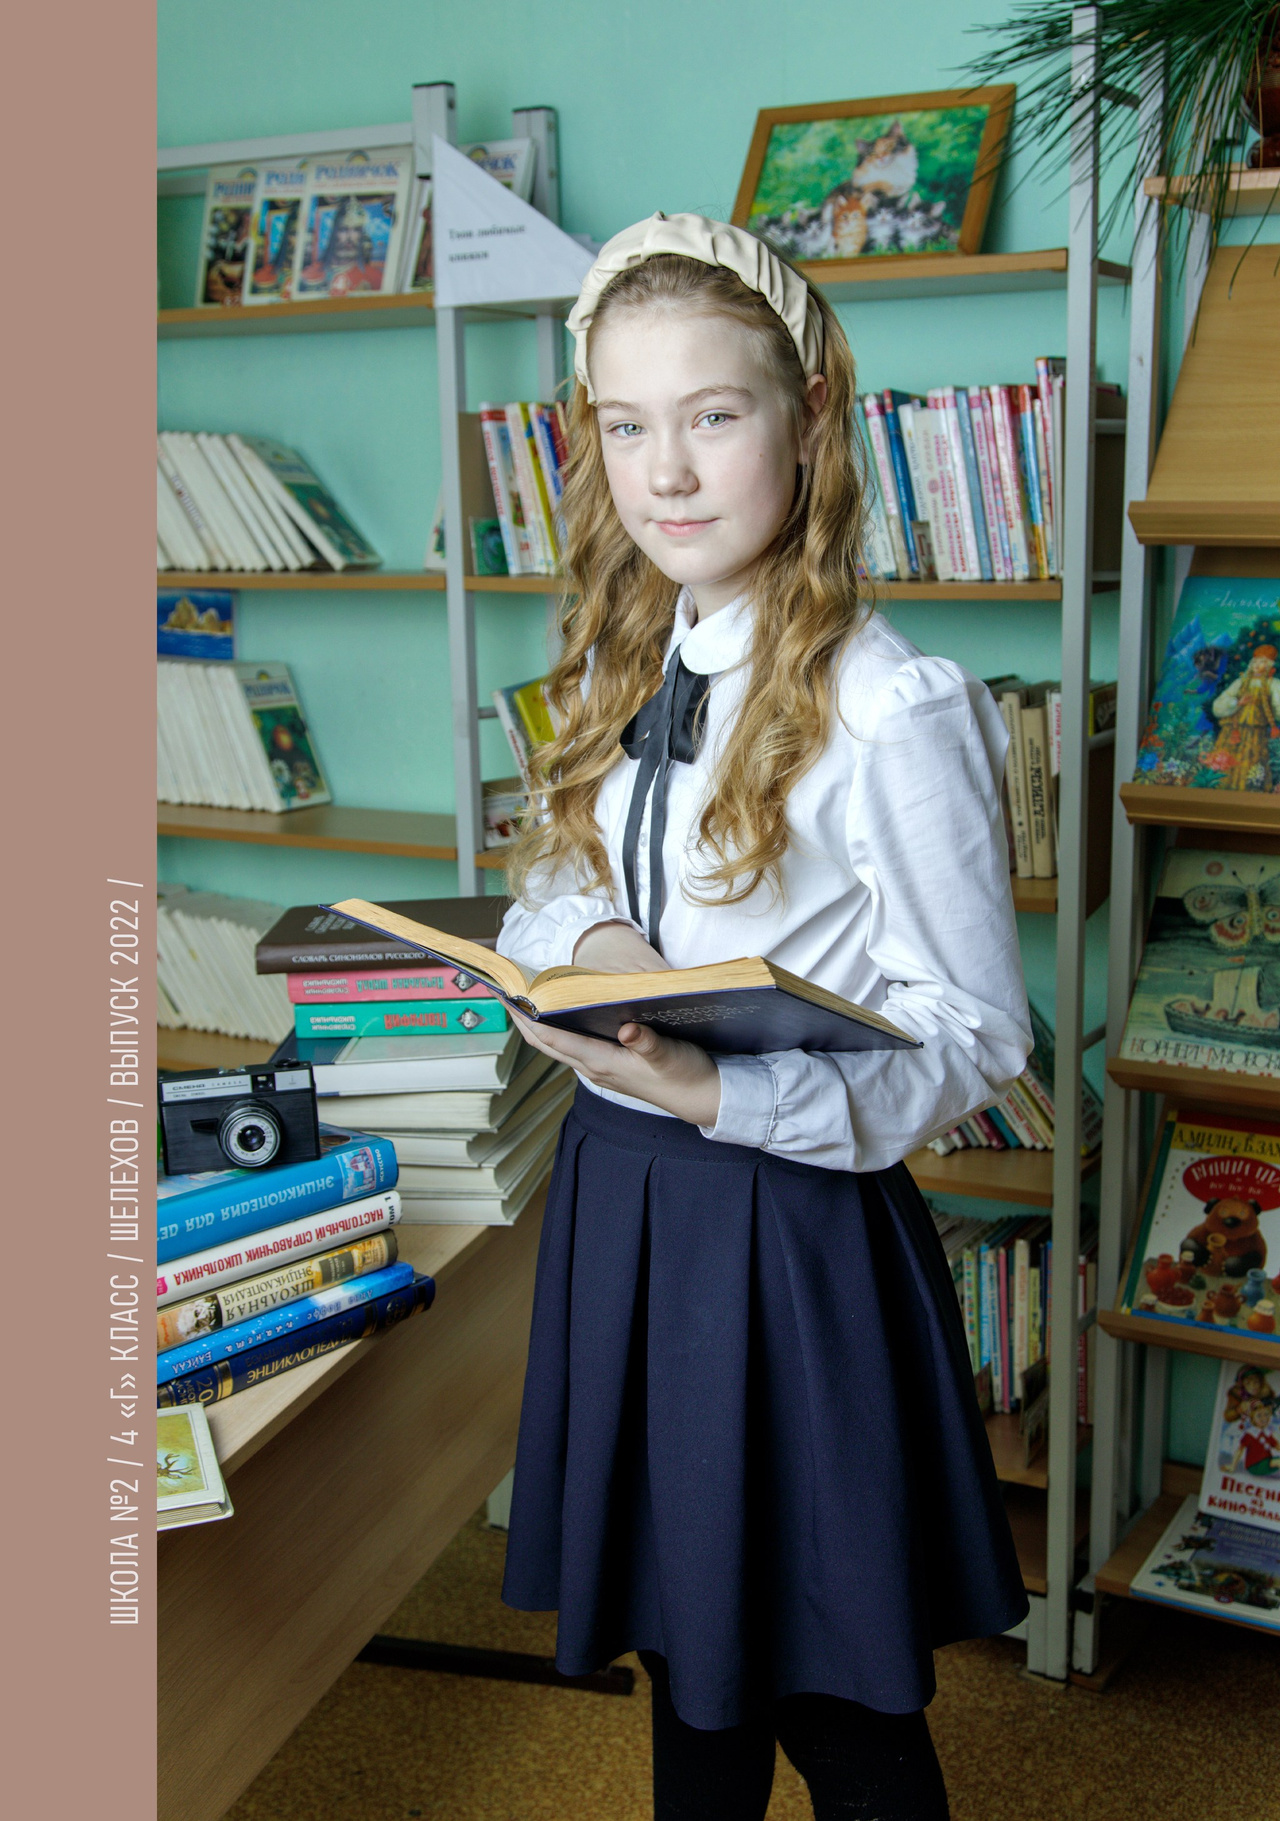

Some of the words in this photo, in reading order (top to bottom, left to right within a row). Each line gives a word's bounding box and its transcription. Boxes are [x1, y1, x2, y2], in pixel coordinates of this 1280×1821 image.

[292, 954, 328, 964] СЛОВАРЬ
[329, 952, 384, 962] СИНОНИМОВ
[374, 1148, 385, 1182] ИСКУССТВО
[220, 1175, 335, 1221] ЭНЦИКЛОПЕДИЯ
[185, 1212, 215, 1232] ДЛЯ
[315, 1208, 385, 1246] НАСТОЛЬНЫЙ
[245, 1231, 314, 1264] СПРАВОЧНИК
[173, 1253, 243, 1286] ШКОЛЬНИКА
[221, 1265, 314, 1306] ЭНЦИКЛОПЕДИЯ
[225, 1278, 315, 1322] ШКОЛЬНАЯ
[172, 1351, 213, 1374] БАЙКАЛ
